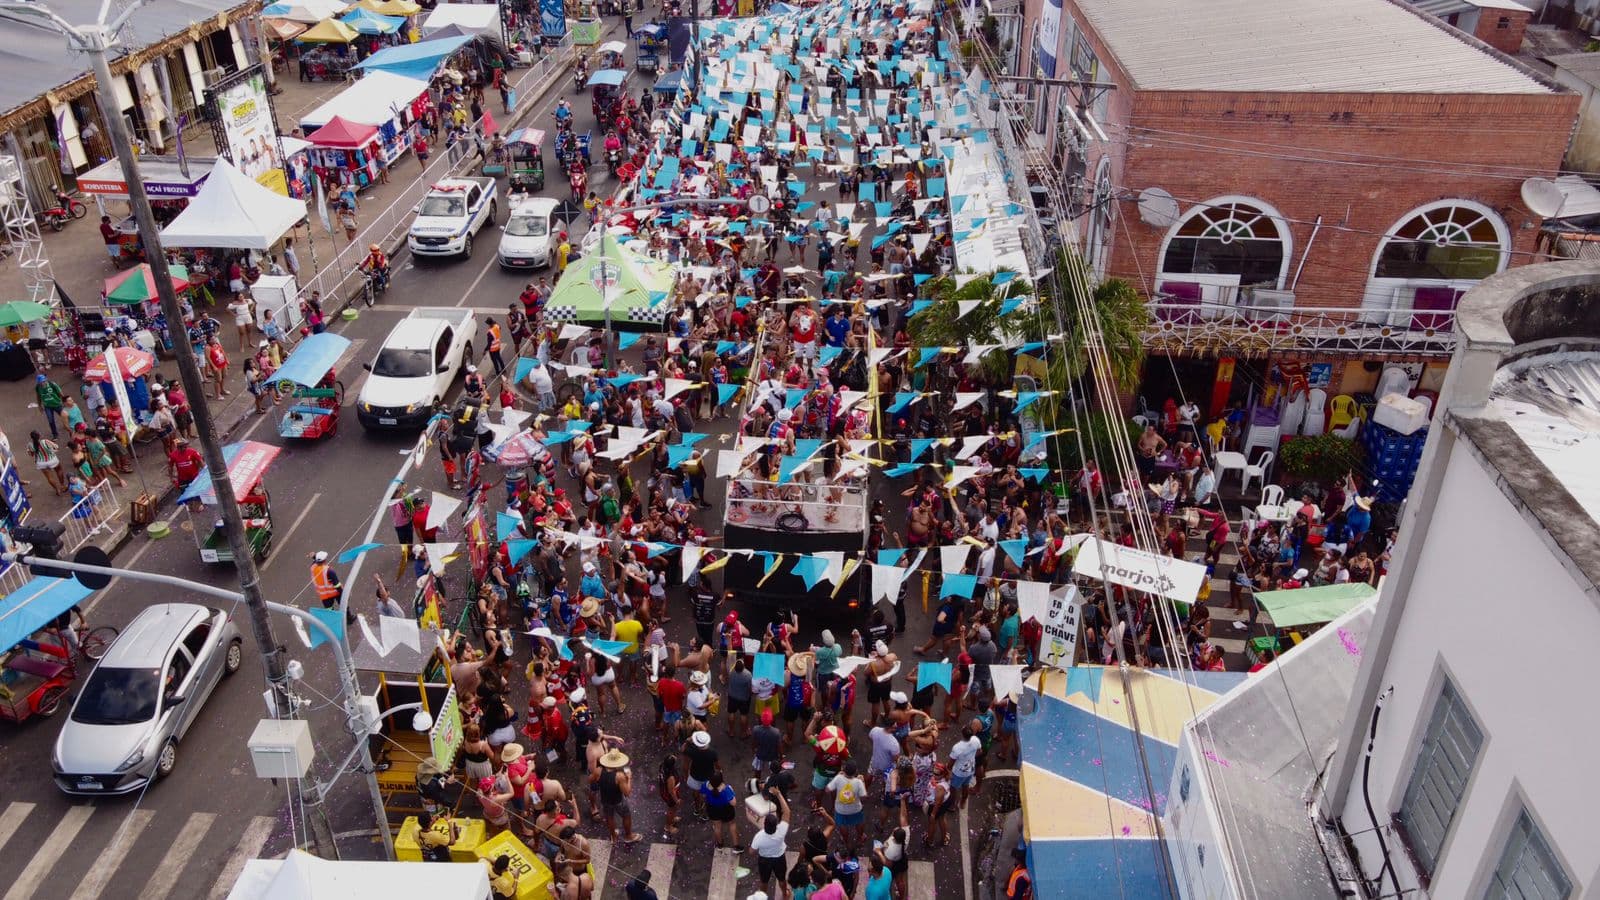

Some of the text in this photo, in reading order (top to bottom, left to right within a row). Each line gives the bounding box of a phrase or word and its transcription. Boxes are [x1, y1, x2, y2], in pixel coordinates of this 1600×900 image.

[1053, 599, 1075, 614] FAO
[1049, 609, 1075, 626] CIA
[1044, 624, 1076, 643] CHAVE
